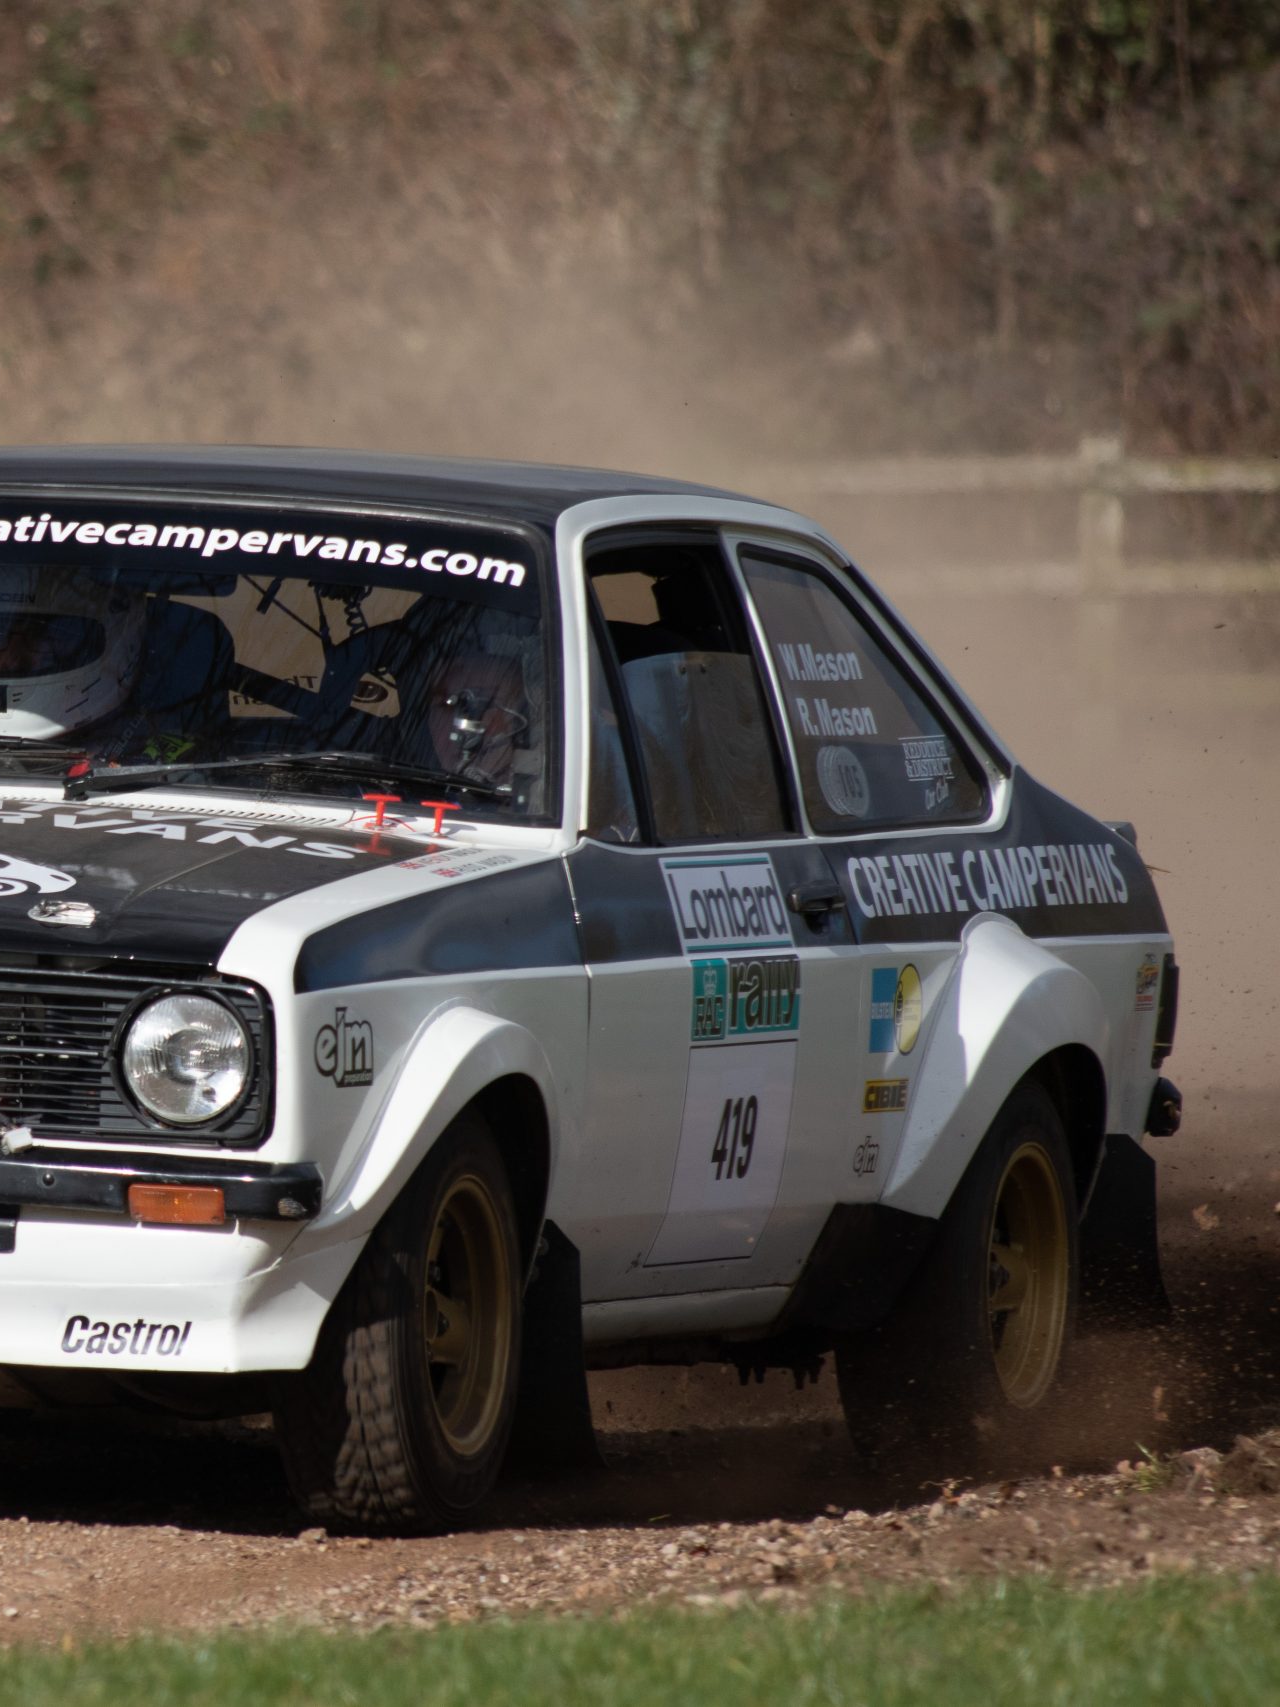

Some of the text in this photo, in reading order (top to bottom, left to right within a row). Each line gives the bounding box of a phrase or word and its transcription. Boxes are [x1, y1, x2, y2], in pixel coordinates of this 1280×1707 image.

[795, 697, 878, 736] R.Mason
[666, 867, 790, 940] Lombard
[847, 843, 1128, 918] CREATIVE CAMPERVANS
[729, 959, 800, 1030] rally
[711, 1095, 758, 1180] 419
[60, 1314, 194, 1357] Castrol
